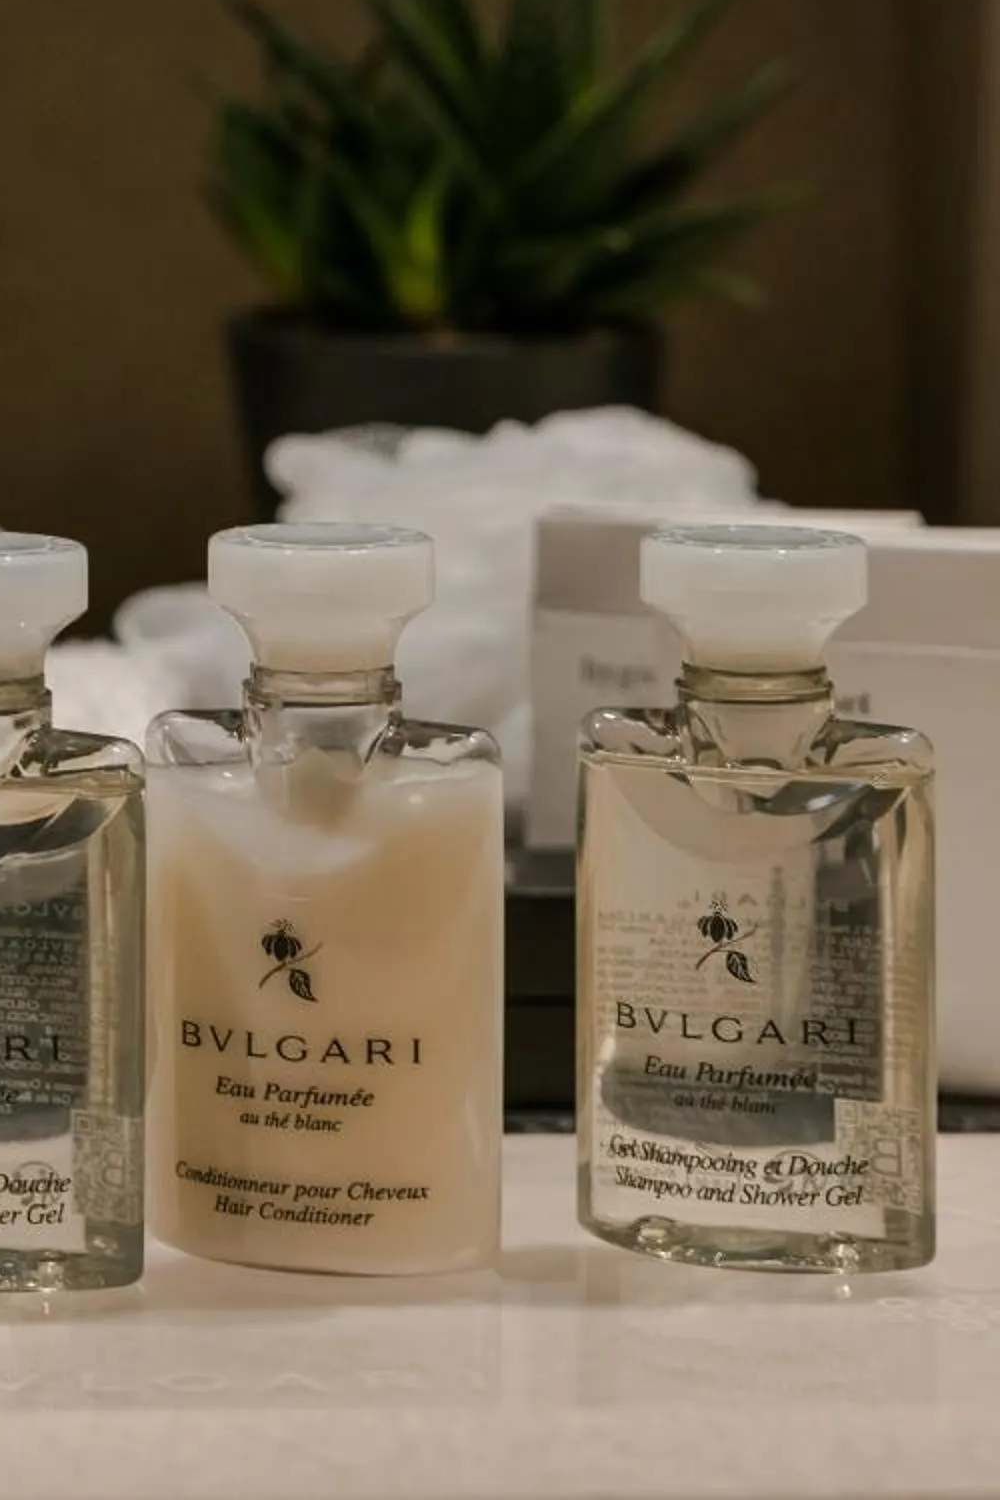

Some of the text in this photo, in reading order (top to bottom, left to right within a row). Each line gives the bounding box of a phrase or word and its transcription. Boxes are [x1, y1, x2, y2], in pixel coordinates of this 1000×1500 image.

[615, 1000, 860, 1046] BVLGARI
[181, 1020, 423, 1065] BVLGARI
[644, 1055, 688, 1079] Eau
[215, 1075, 376, 1109] Eau Parfumée
[239, 1110, 343, 1134] au thé blanc
[640, 1140, 758, 1180] Shampooing
[787, 1155, 869, 1177] Douche
[175, 1160, 431, 1204] Conditionneur pour Cheveux
[615, 1164, 864, 1207] Shampoo and Shower Gel
[26, 1202, 66, 1227] Gel
[214, 1194, 375, 1227] Hair Conditioner
